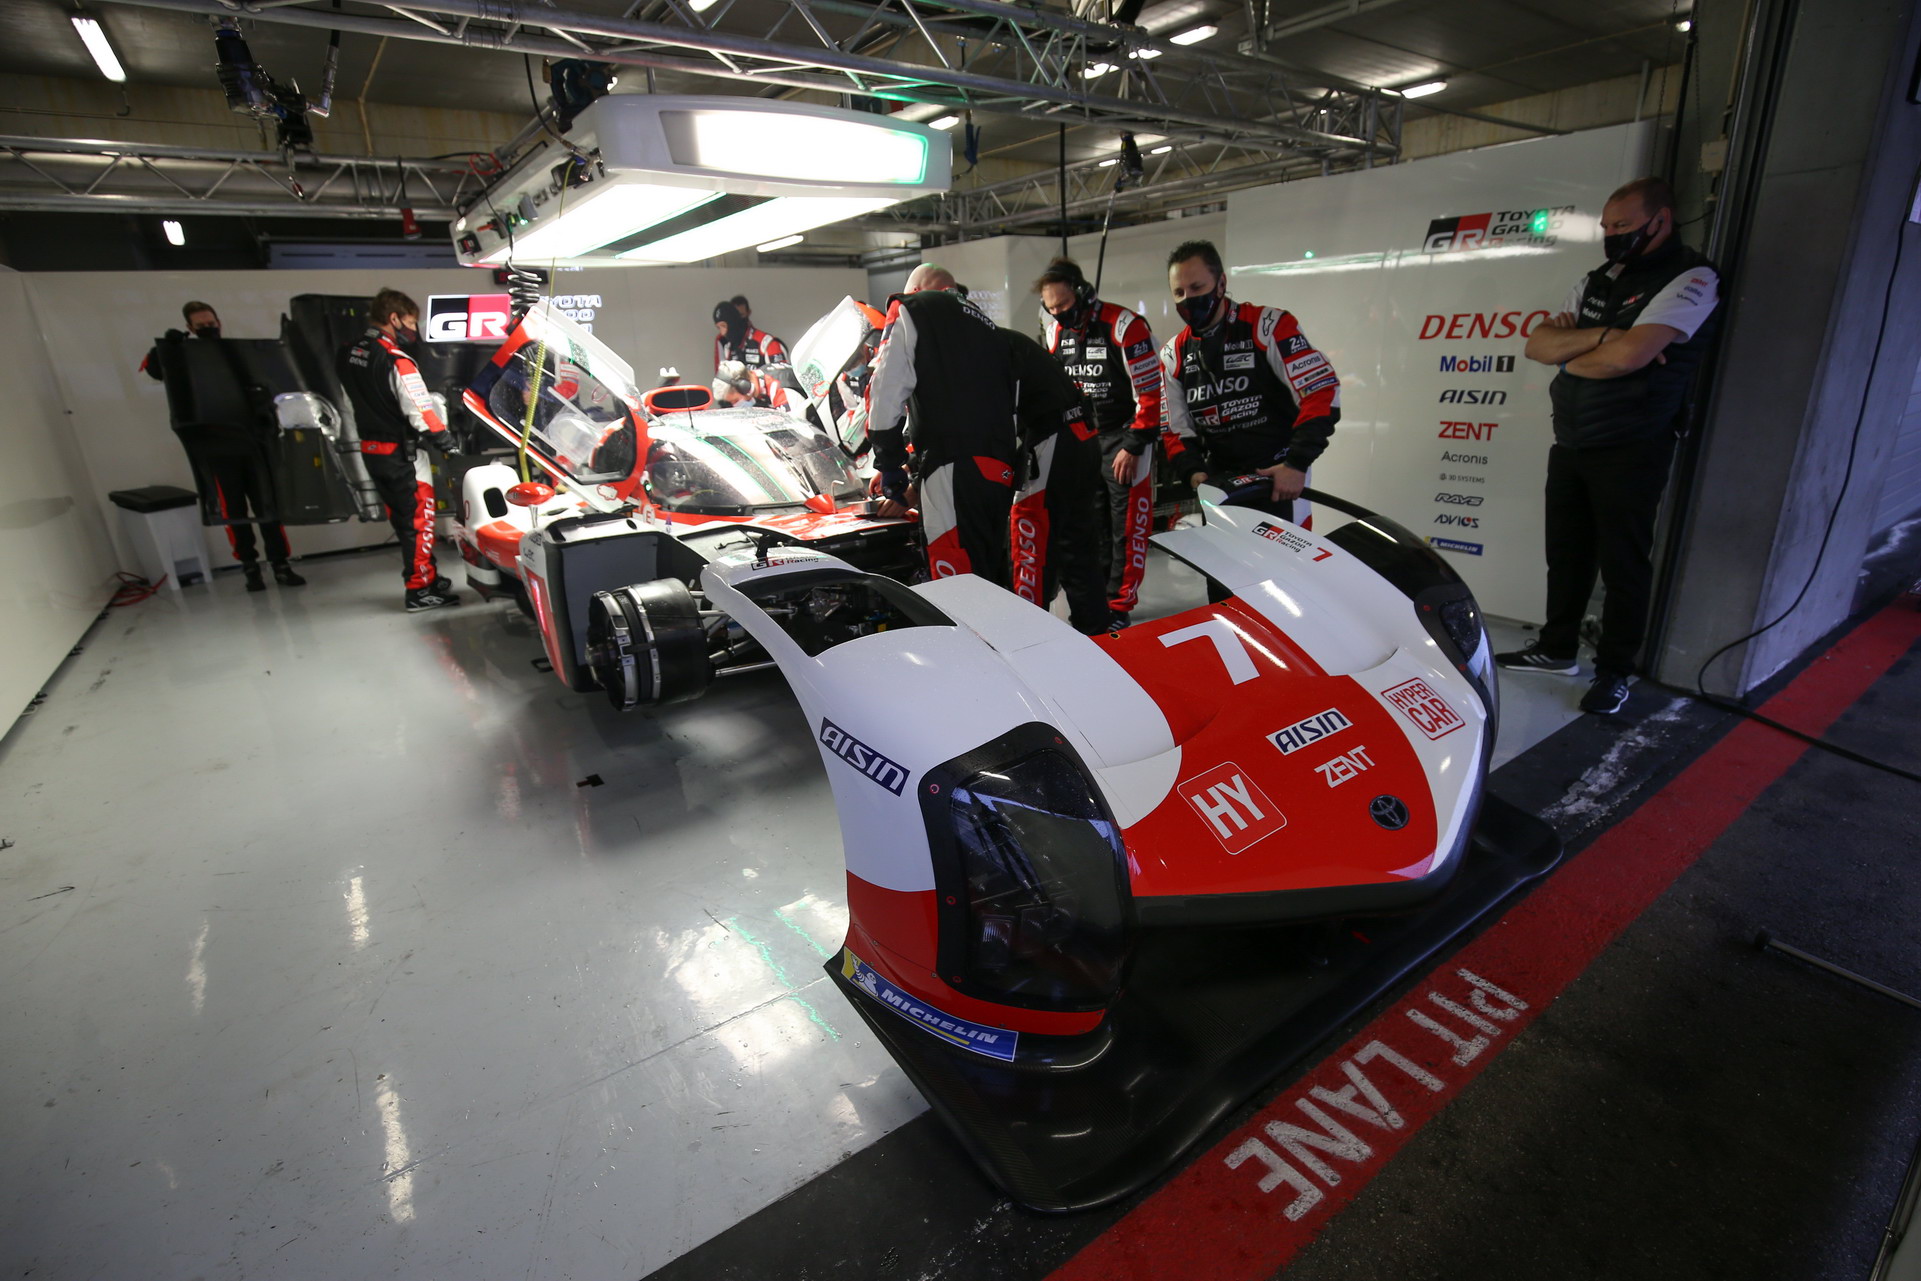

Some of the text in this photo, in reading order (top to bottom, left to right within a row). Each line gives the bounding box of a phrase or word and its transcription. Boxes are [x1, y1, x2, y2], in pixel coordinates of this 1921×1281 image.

[1424, 228, 1485, 252] GR
[430, 311, 508, 338] GR
[963, 306, 996, 330] DENSO
[1292, 355, 1321, 373] Acronis
[1440, 355, 1493, 372] Mobil
[1187, 376, 1249, 404] DENSO
[1439, 389, 1507, 405] AISIN
[1221, 395, 1263, 409] TOYOTA
[1222, 402, 1260, 416] GAZOO
[1221, 409, 1258, 423] Racing
[1438, 421, 1499, 441] ZENT
[1441, 451, 1488, 465] Acronis
[1458, 475, 1485, 484] SYSTEMS
[1435, 493, 1484, 507] RAYS
[421, 496, 436, 555] DENSO
[1132, 497, 1150, 569] DENSO
[1253, 526, 1278, 540] GR
[1275, 538, 1301, 553] Racing
[1280, 534, 1306, 549] GAZOO
[1285, 531, 1312, 547] TOYOTA
[1440, 541, 1478, 552] MICHELIN
[1018, 518, 1036, 603] DENSO
[1312, 547, 1333, 562] 7
[1157, 619, 1260, 686] 7
[1389, 682, 1435, 710] HYPER
[1407, 700, 1456, 733] CAR
[1275, 710, 1349, 753] AISIN
[822, 724, 906, 794] AISIN
[1314, 745, 1376, 789] ZENT
[1191, 773, 1266, 839] HY
[881, 988, 999, 1045] MICHELIN
[1223, 968, 1529, 1222] PIT LANE
